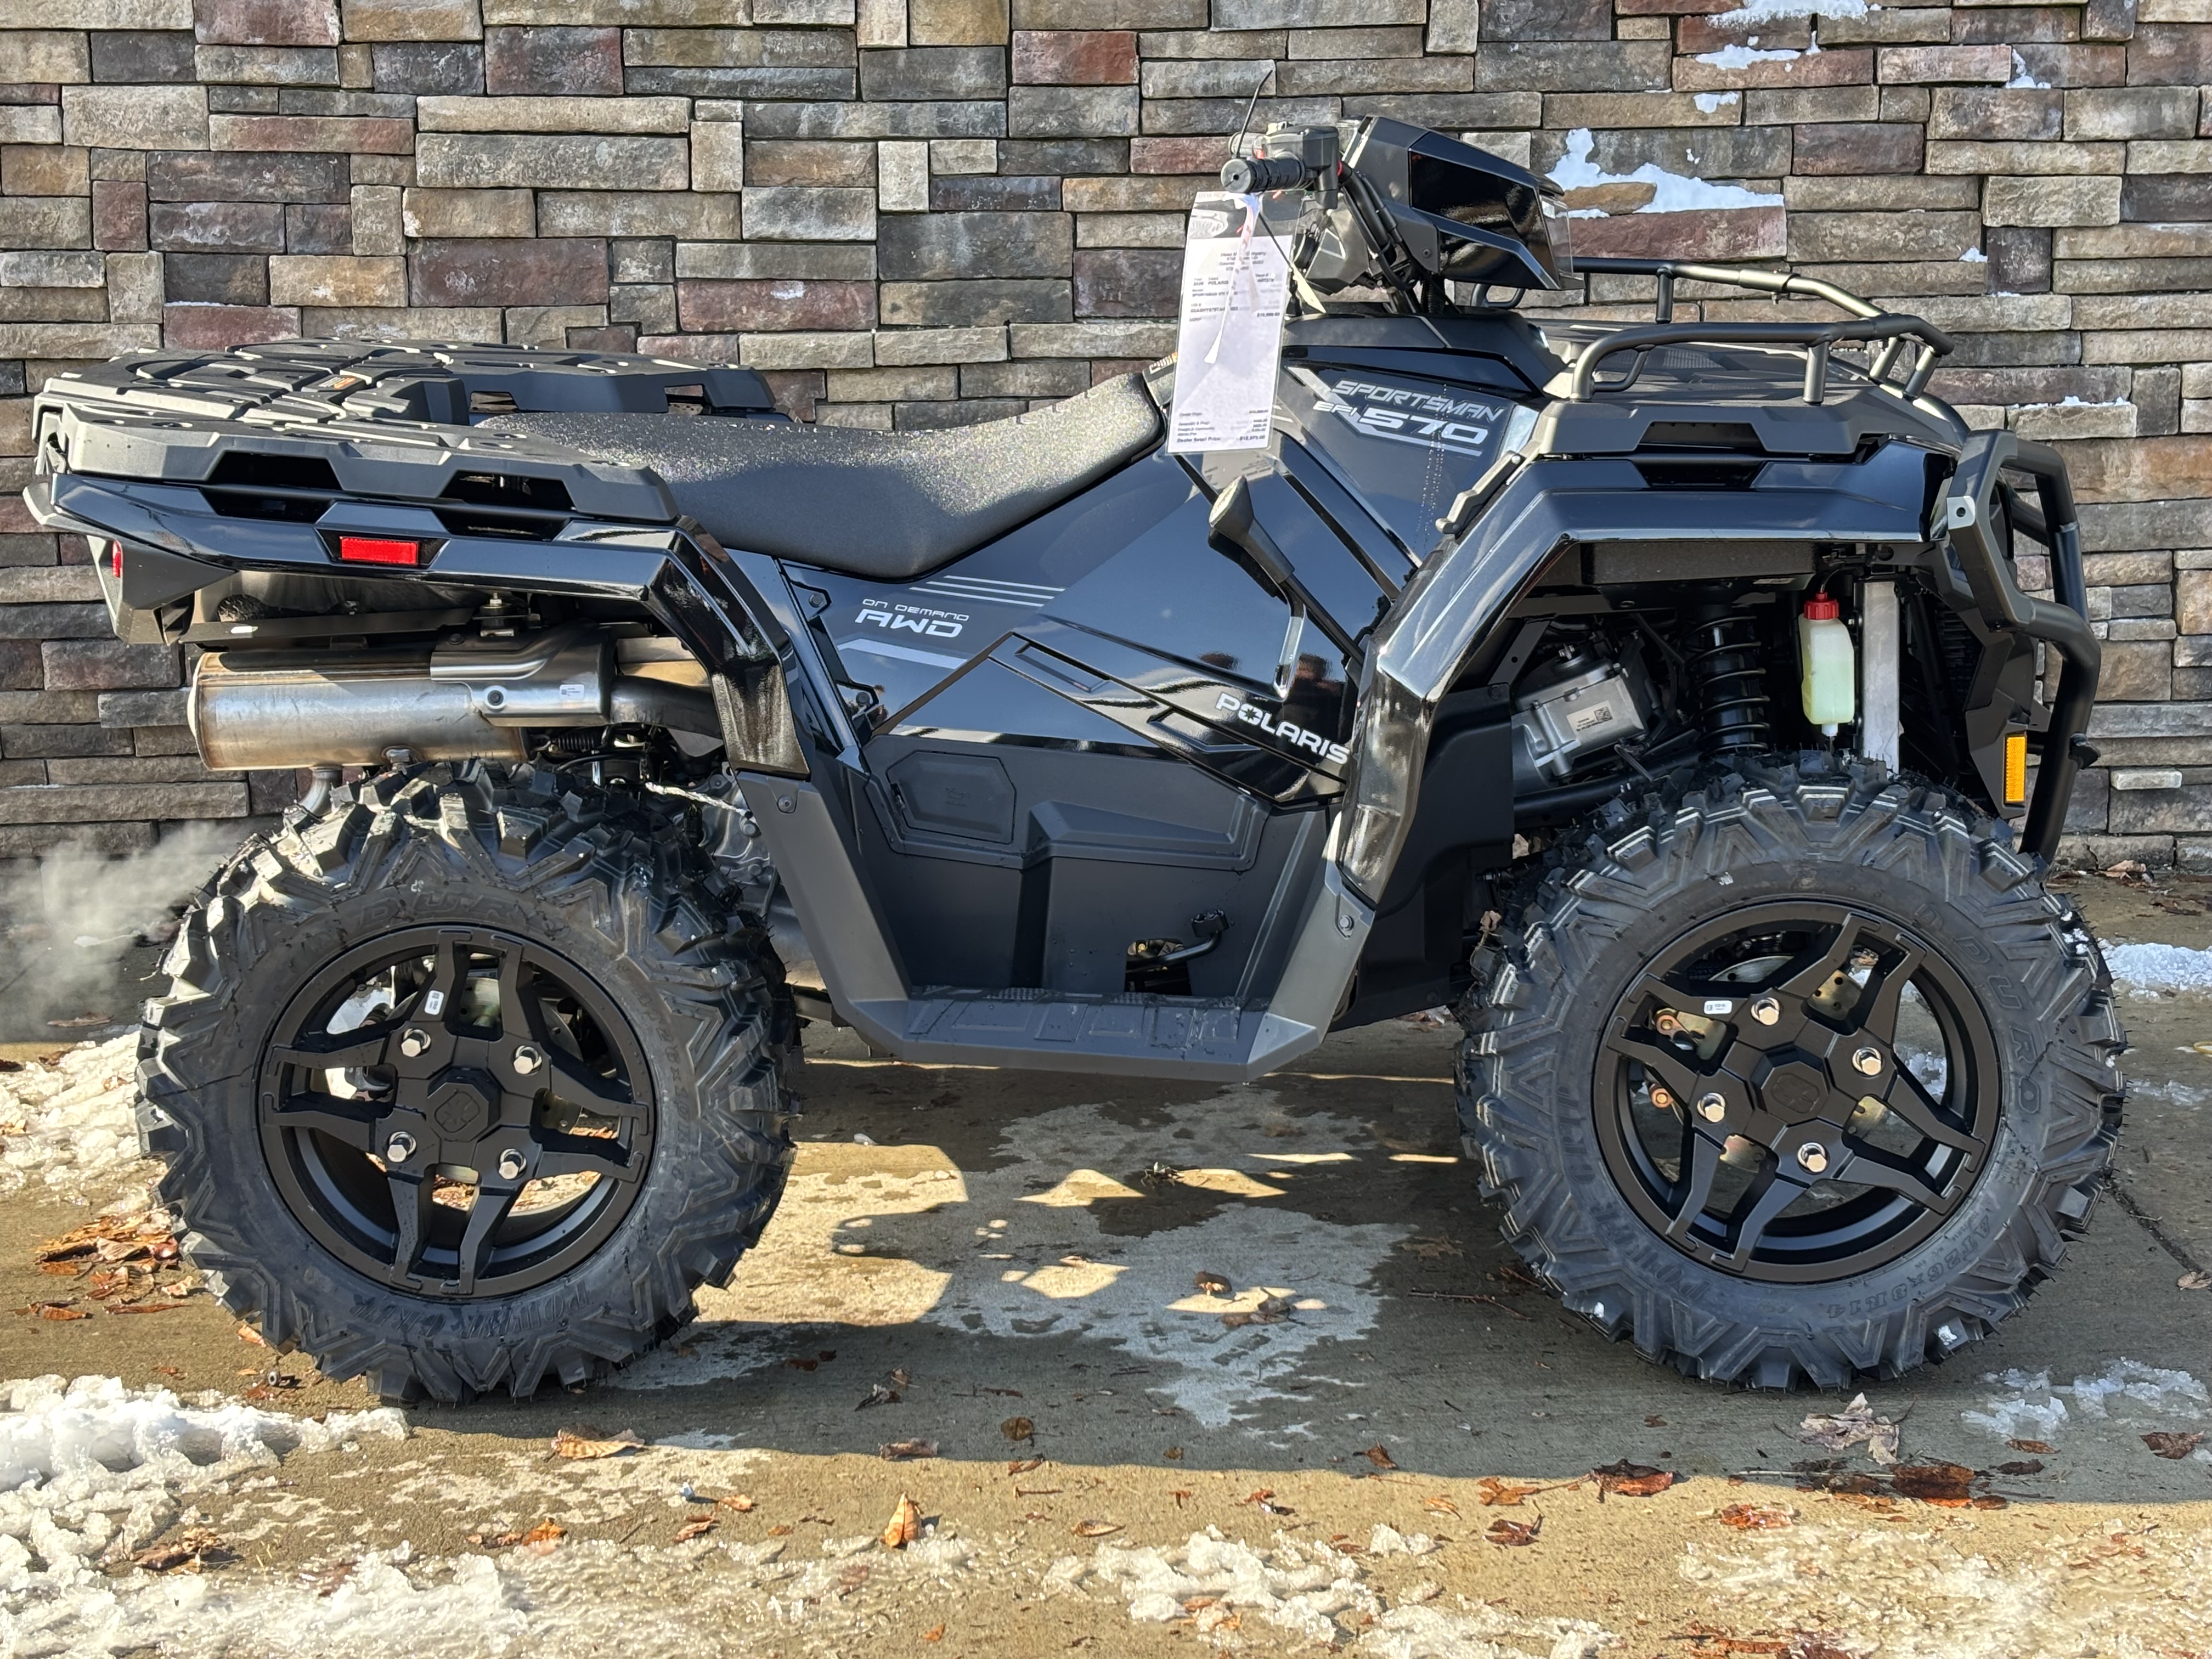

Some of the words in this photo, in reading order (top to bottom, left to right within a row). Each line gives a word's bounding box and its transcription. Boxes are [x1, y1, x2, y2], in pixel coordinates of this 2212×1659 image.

[1313, 400, 1358, 416] EFI
[1359, 407, 1488, 445] 570
[1330, 380, 1505, 422] SPORTSMAN
[854, 608, 964, 638] AWD
[862, 598, 888, 608] ON
[894, 604, 970, 622] DEMAND
[1215, 693, 1351, 765] POLARIS
[1953, 935, 2041, 1115] DURO
[1826, 1214, 1990, 1319] AT26x8R14
